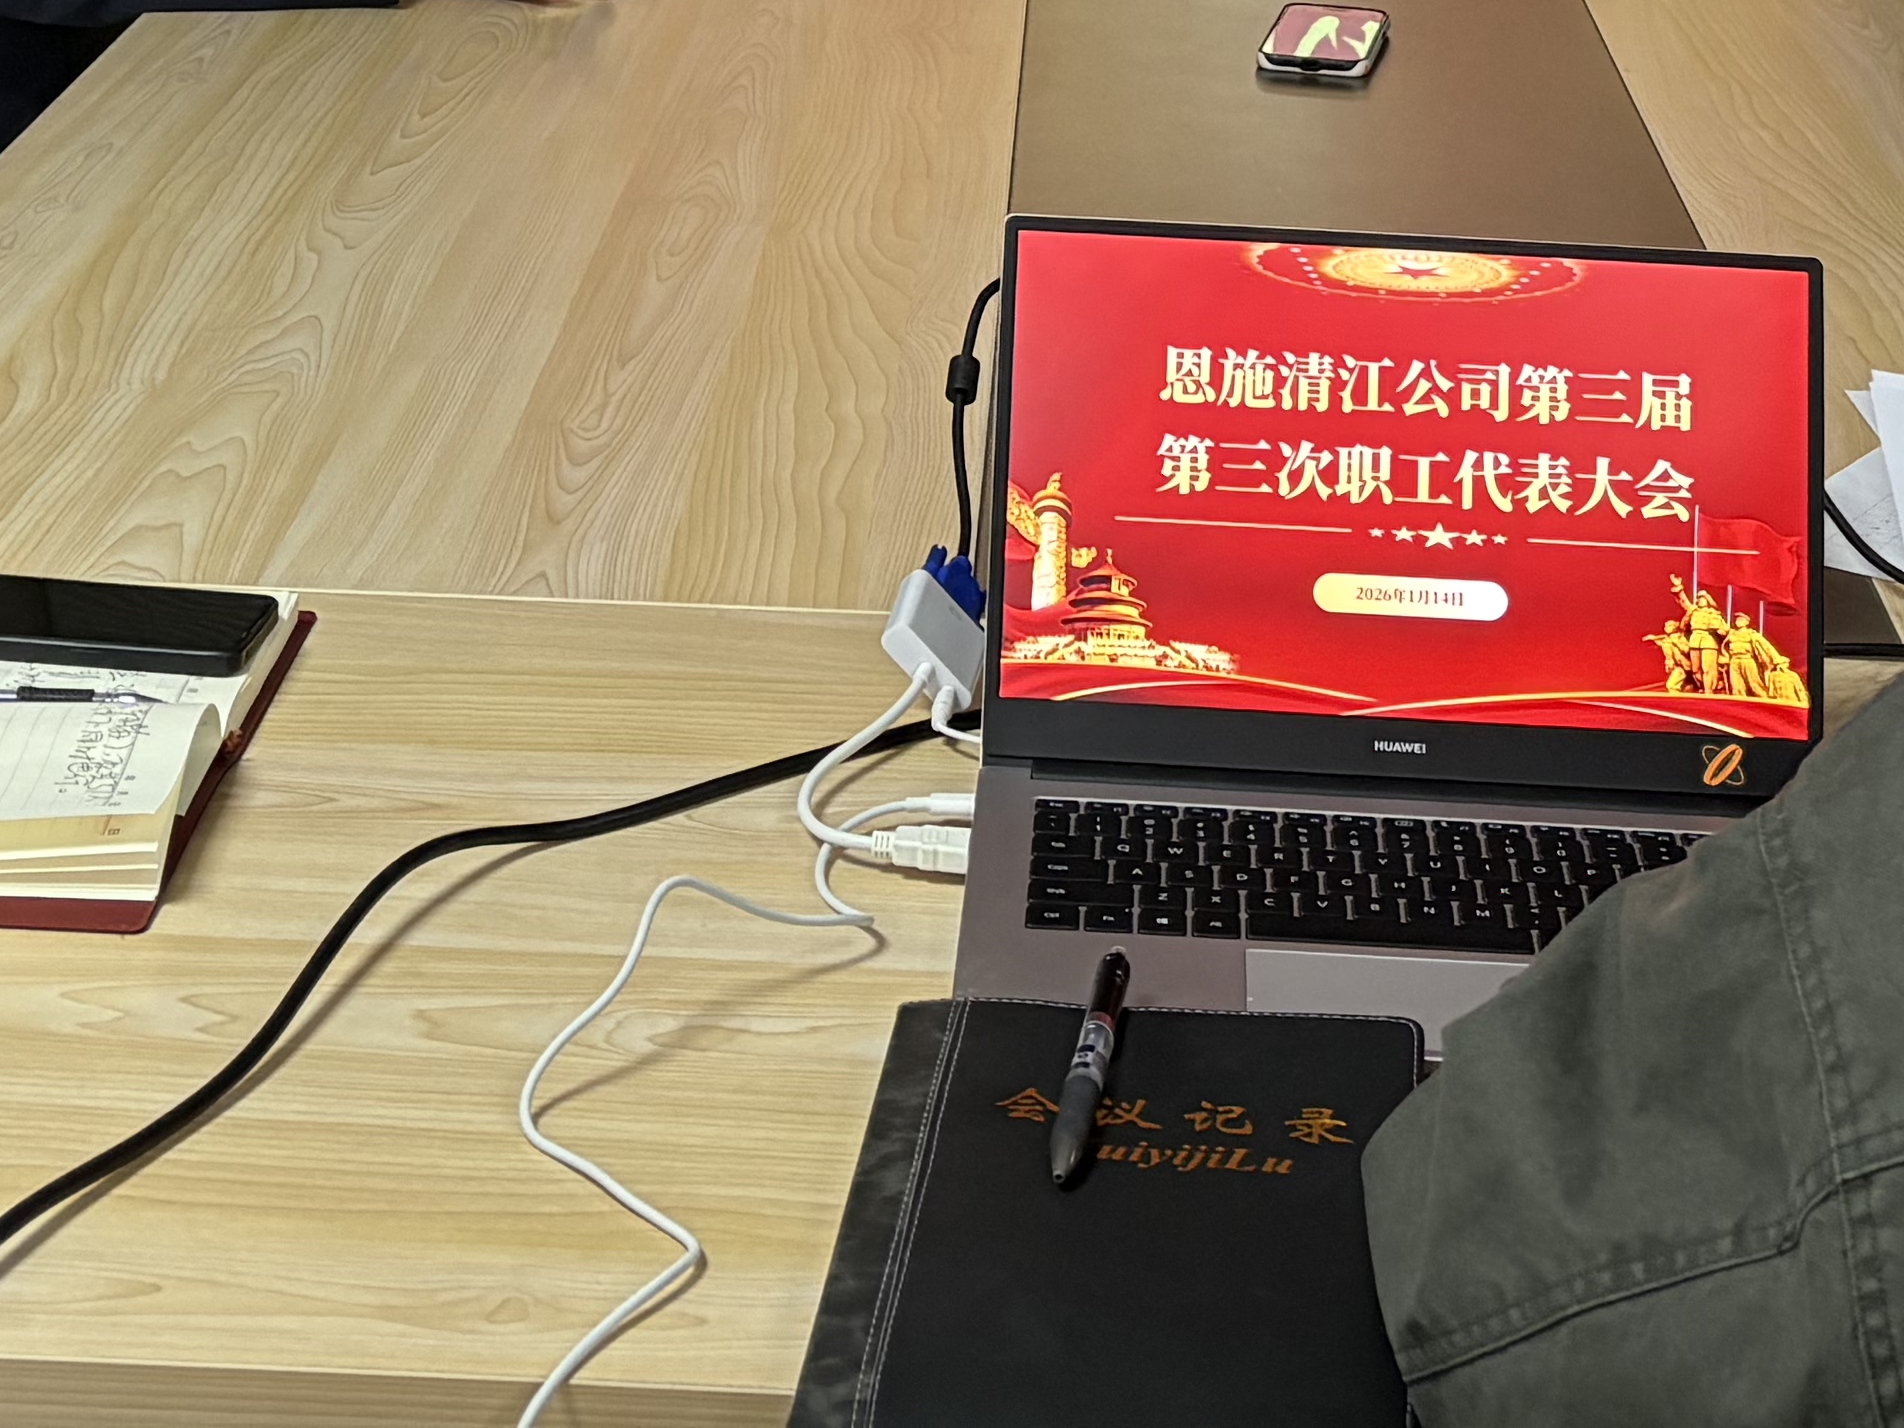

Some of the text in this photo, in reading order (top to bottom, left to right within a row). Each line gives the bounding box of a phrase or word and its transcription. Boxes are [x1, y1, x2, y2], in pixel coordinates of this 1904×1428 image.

[1158, 346, 1693, 432] 恩施清江公司第三届
[1155, 433, 1695, 522] 第三次职工代表大会
[1355, 587, 1464, 607] 2026年1月14日
[1374, 740, 1427, 755] HUAWEI
[996, 1087, 1355, 1144] 会议记录
[1097, 1141, 1293, 1175] uiyijiLu
